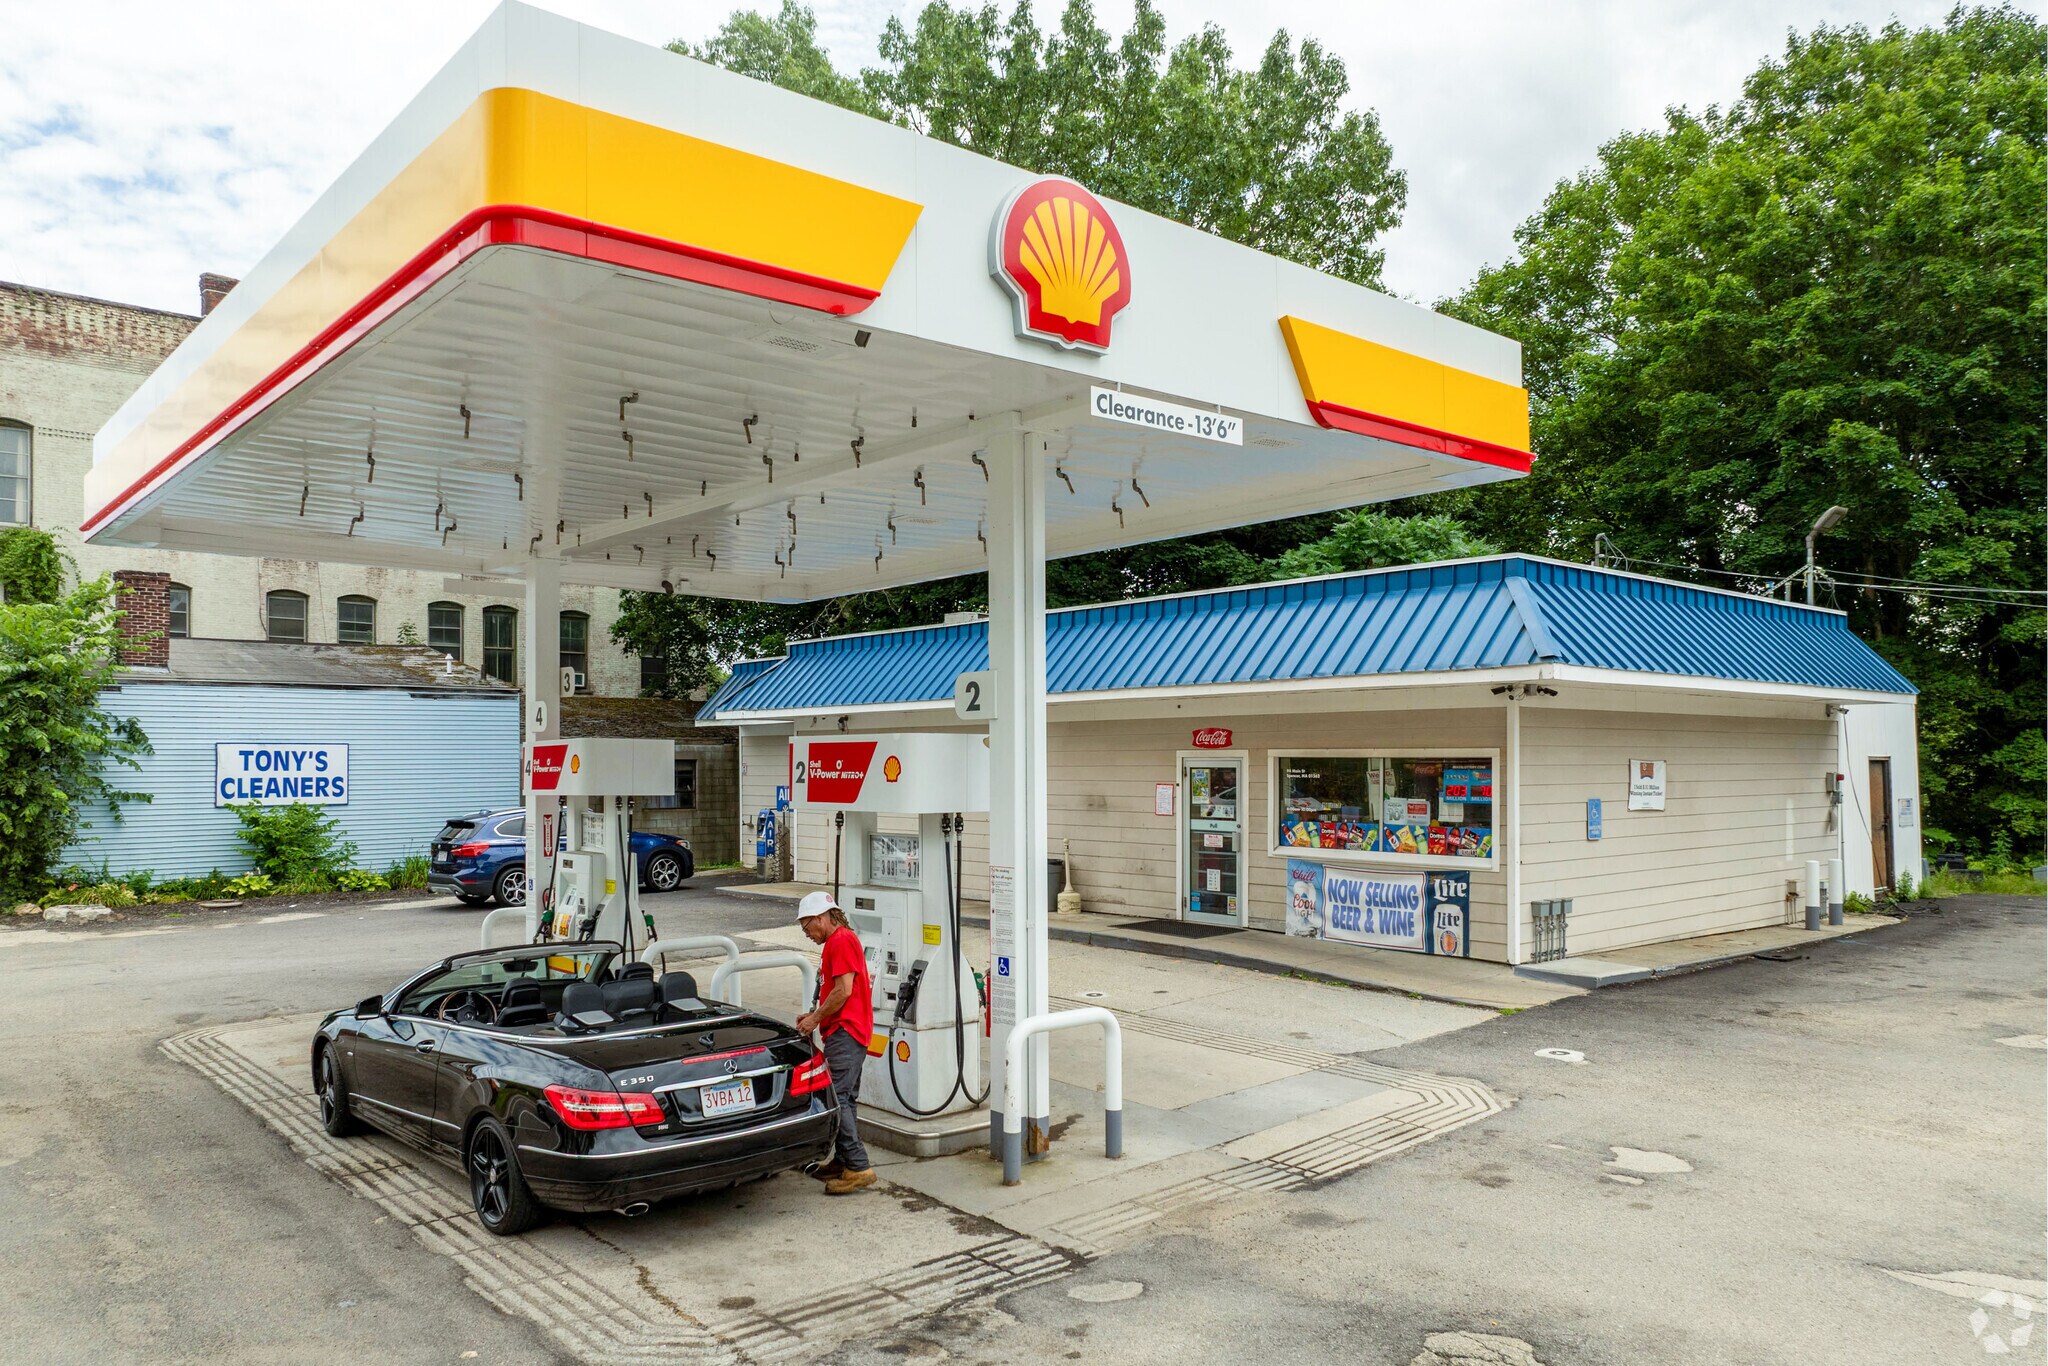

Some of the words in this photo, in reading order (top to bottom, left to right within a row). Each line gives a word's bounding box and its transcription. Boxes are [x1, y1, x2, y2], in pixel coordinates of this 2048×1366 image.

[1096, 393, 1185, 431] Clearance
[563, 672, 571, 693] 3
[965, 680, 981, 712] 2
[535, 707, 543, 726] 4
[1195, 730, 1229, 745] Coca-Cola
[238, 750, 329, 772] TONY'S
[525, 760, 532, 777] 4
[809, 760, 822, 768] Shell
[795, 760, 806, 784] 2
[809, 768, 839, 779] V-Power
[220, 776, 345, 800] CLEANERS
[1446, 785, 1467, 796] 203
[767, 820, 775, 848] AIR
[1292, 868, 1317, 882] Chill
[1327, 878, 1363, 906] NOW
[1365, 881, 1419, 911] SELLING
[1433, 878, 1467, 902] Lite
[1331, 904, 1362, 932] BEER
[1364, 908, 1375, 934] &
[1379, 909, 1415, 937] WINE
[1437, 911, 1460, 930] Lite
[630, 1075, 654, 1085] 350
[704, 1089, 735, 1109] 3VBA
[737, 1086, 752, 1103] 12
